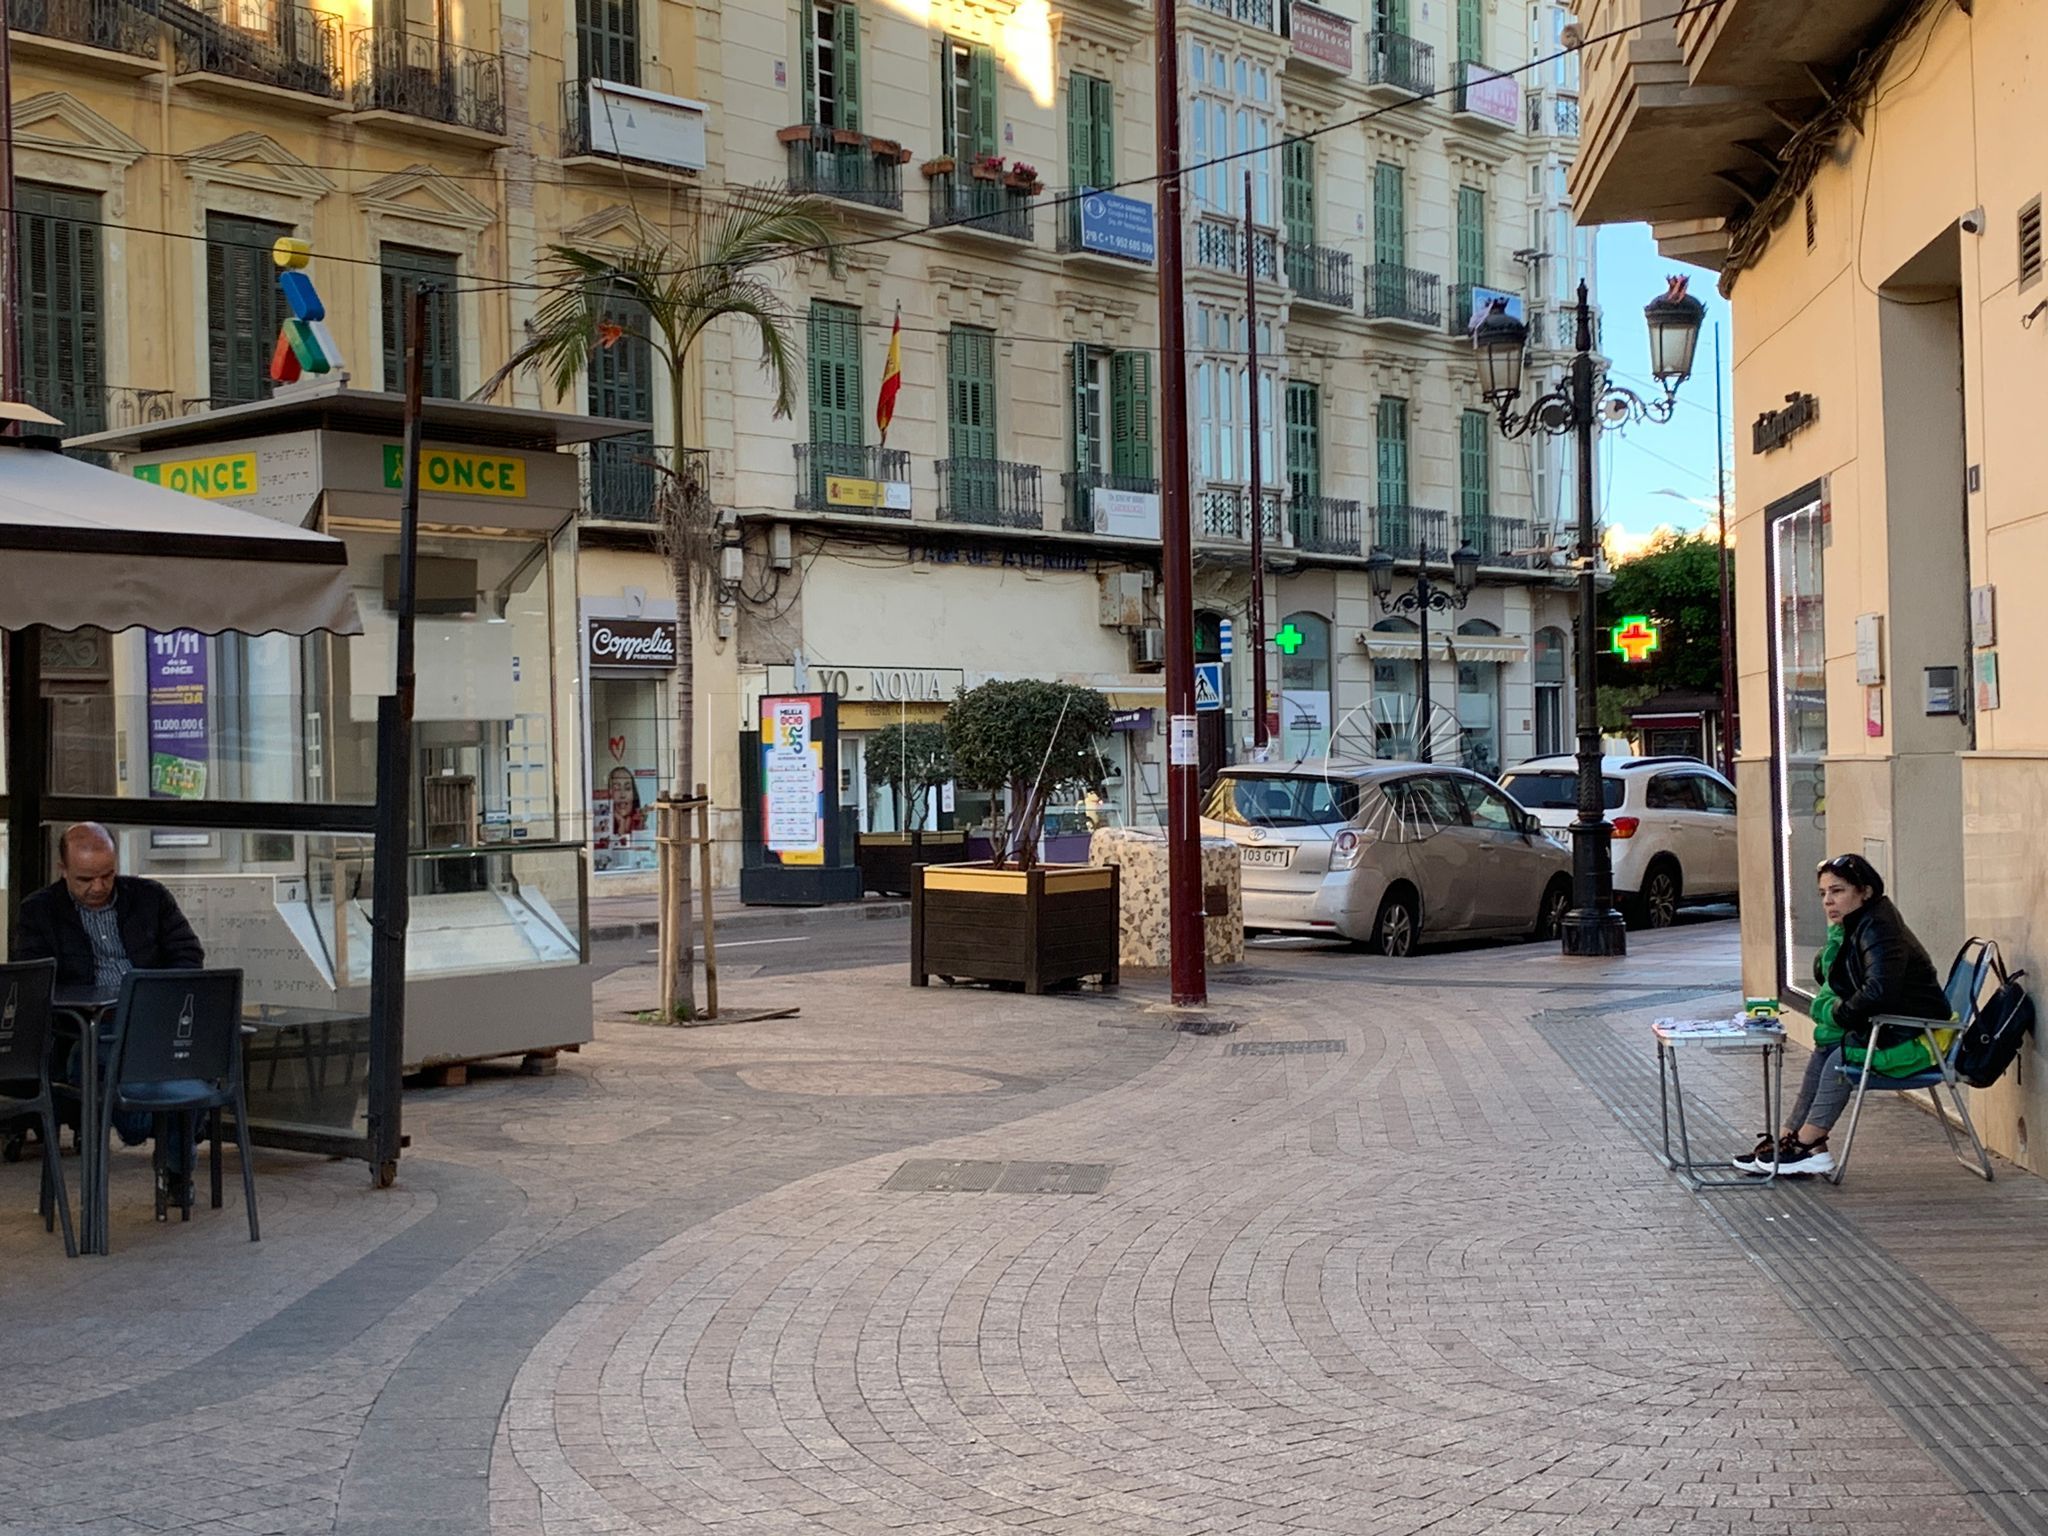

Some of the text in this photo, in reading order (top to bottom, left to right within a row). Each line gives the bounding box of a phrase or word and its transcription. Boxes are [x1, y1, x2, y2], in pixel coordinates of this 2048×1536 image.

[170, 460, 248, 494] ONCE
[429, 456, 515, 491] ONCE
[154, 630, 199, 658] 11/11
[592, 627, 674, 660] Coppelia
[161, 665, 195, 675] ONCE
[817, 670, 849, 699] YO
[870, 671, 943, 701] NOVIA
[780, 716, 804, 726] OCIO
[1243, 849, 1285, 863] 103 GYT
